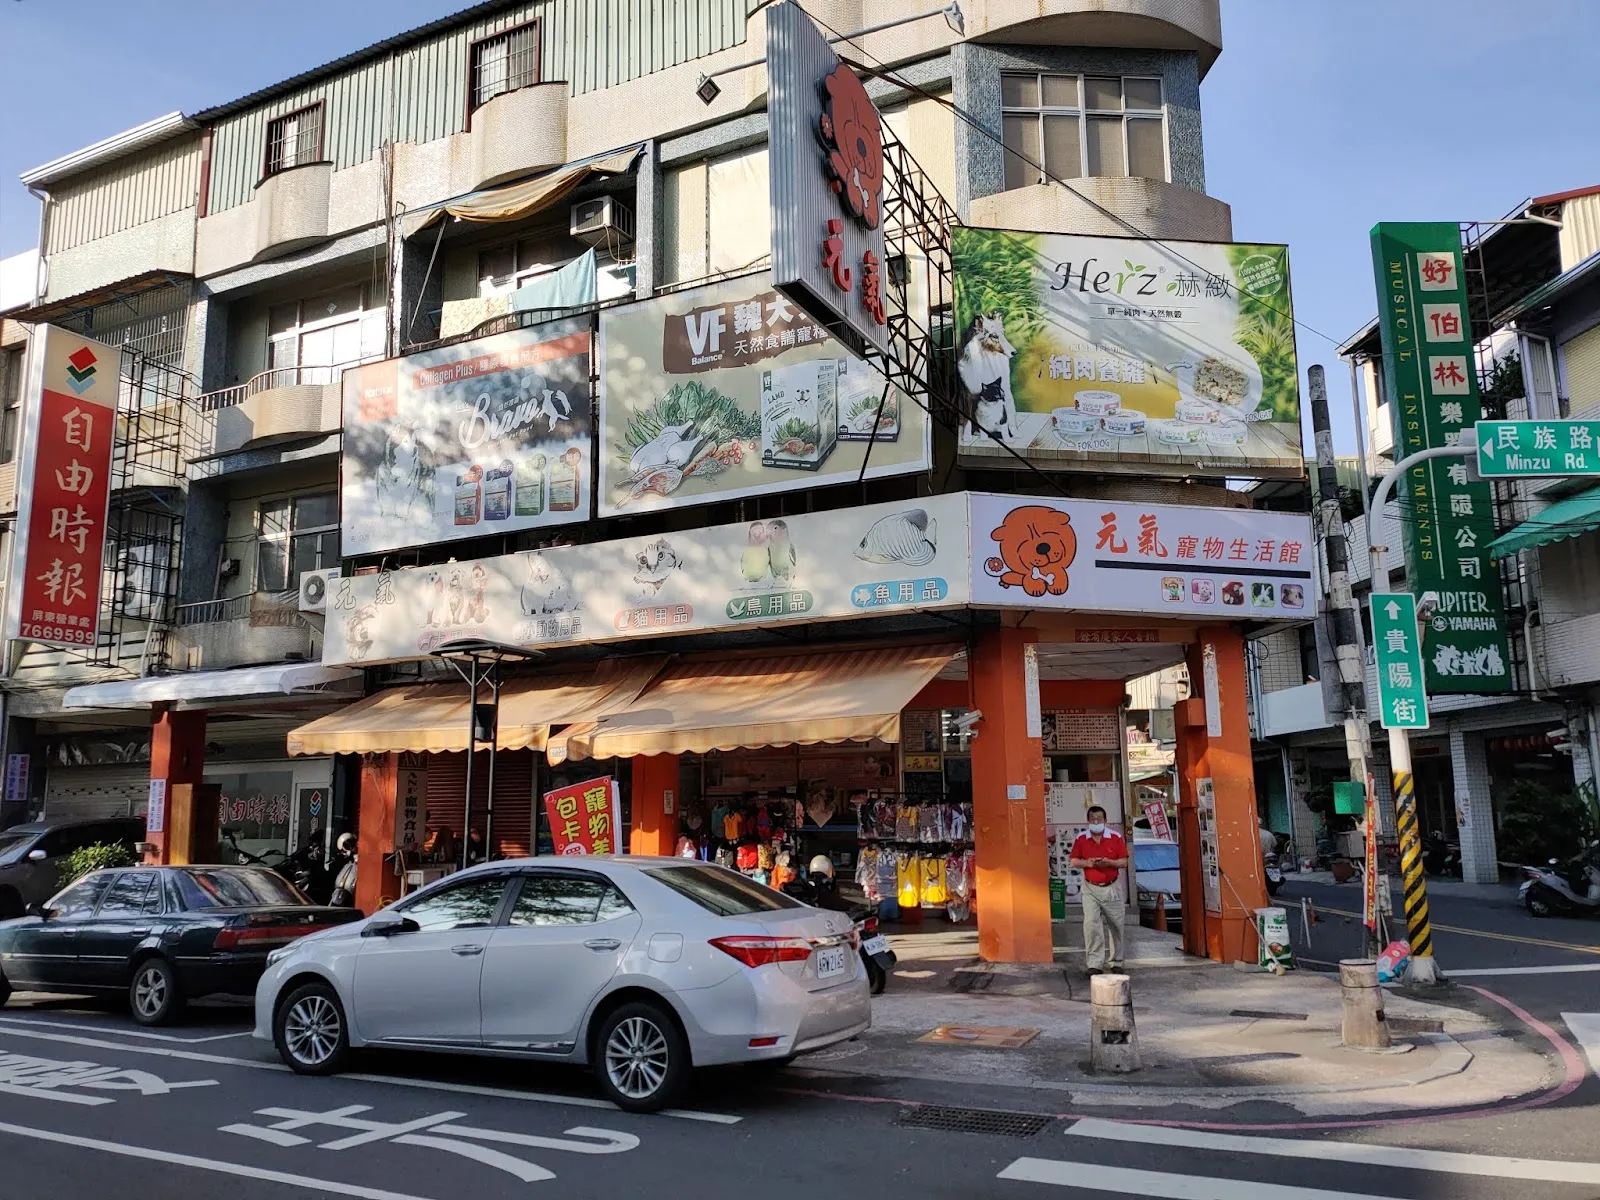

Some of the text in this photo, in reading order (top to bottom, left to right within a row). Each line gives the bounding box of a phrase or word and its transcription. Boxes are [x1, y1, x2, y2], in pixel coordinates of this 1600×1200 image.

[1050, 258, 1232, 299] Herz 赫緻
[733, 293, 809, 335] 魏大
[1421, 259, 1465, 387] 好伯林
[684, 308, 727, 357] VF
[691, 352, 723, 366] Balance
[420, 368, 453, 386] Collagen
[1389, 261, 1434, 561] MUSICAL INSTUMENTS
[1093, 439, 1110, 449] DOG
[1496, 425, 1594, 451] 民族路
[1506, 454, 1588, 471] Minzu Rd.
[36, 405, 95, 607] 自由時報
[1095, 511, 1303, 564] 元氣 寵物生活館
[745, 592, 806, 615] 鳥用品
[872, 581, 941, 604] 魚用品
[631, 605, 689, 628] 貓用品
[1449, 616, 1497, 631] YAMAHA
[22, 623, 95, 645] 7669599
[1384, 630, 1417, 724] 貴陽街
